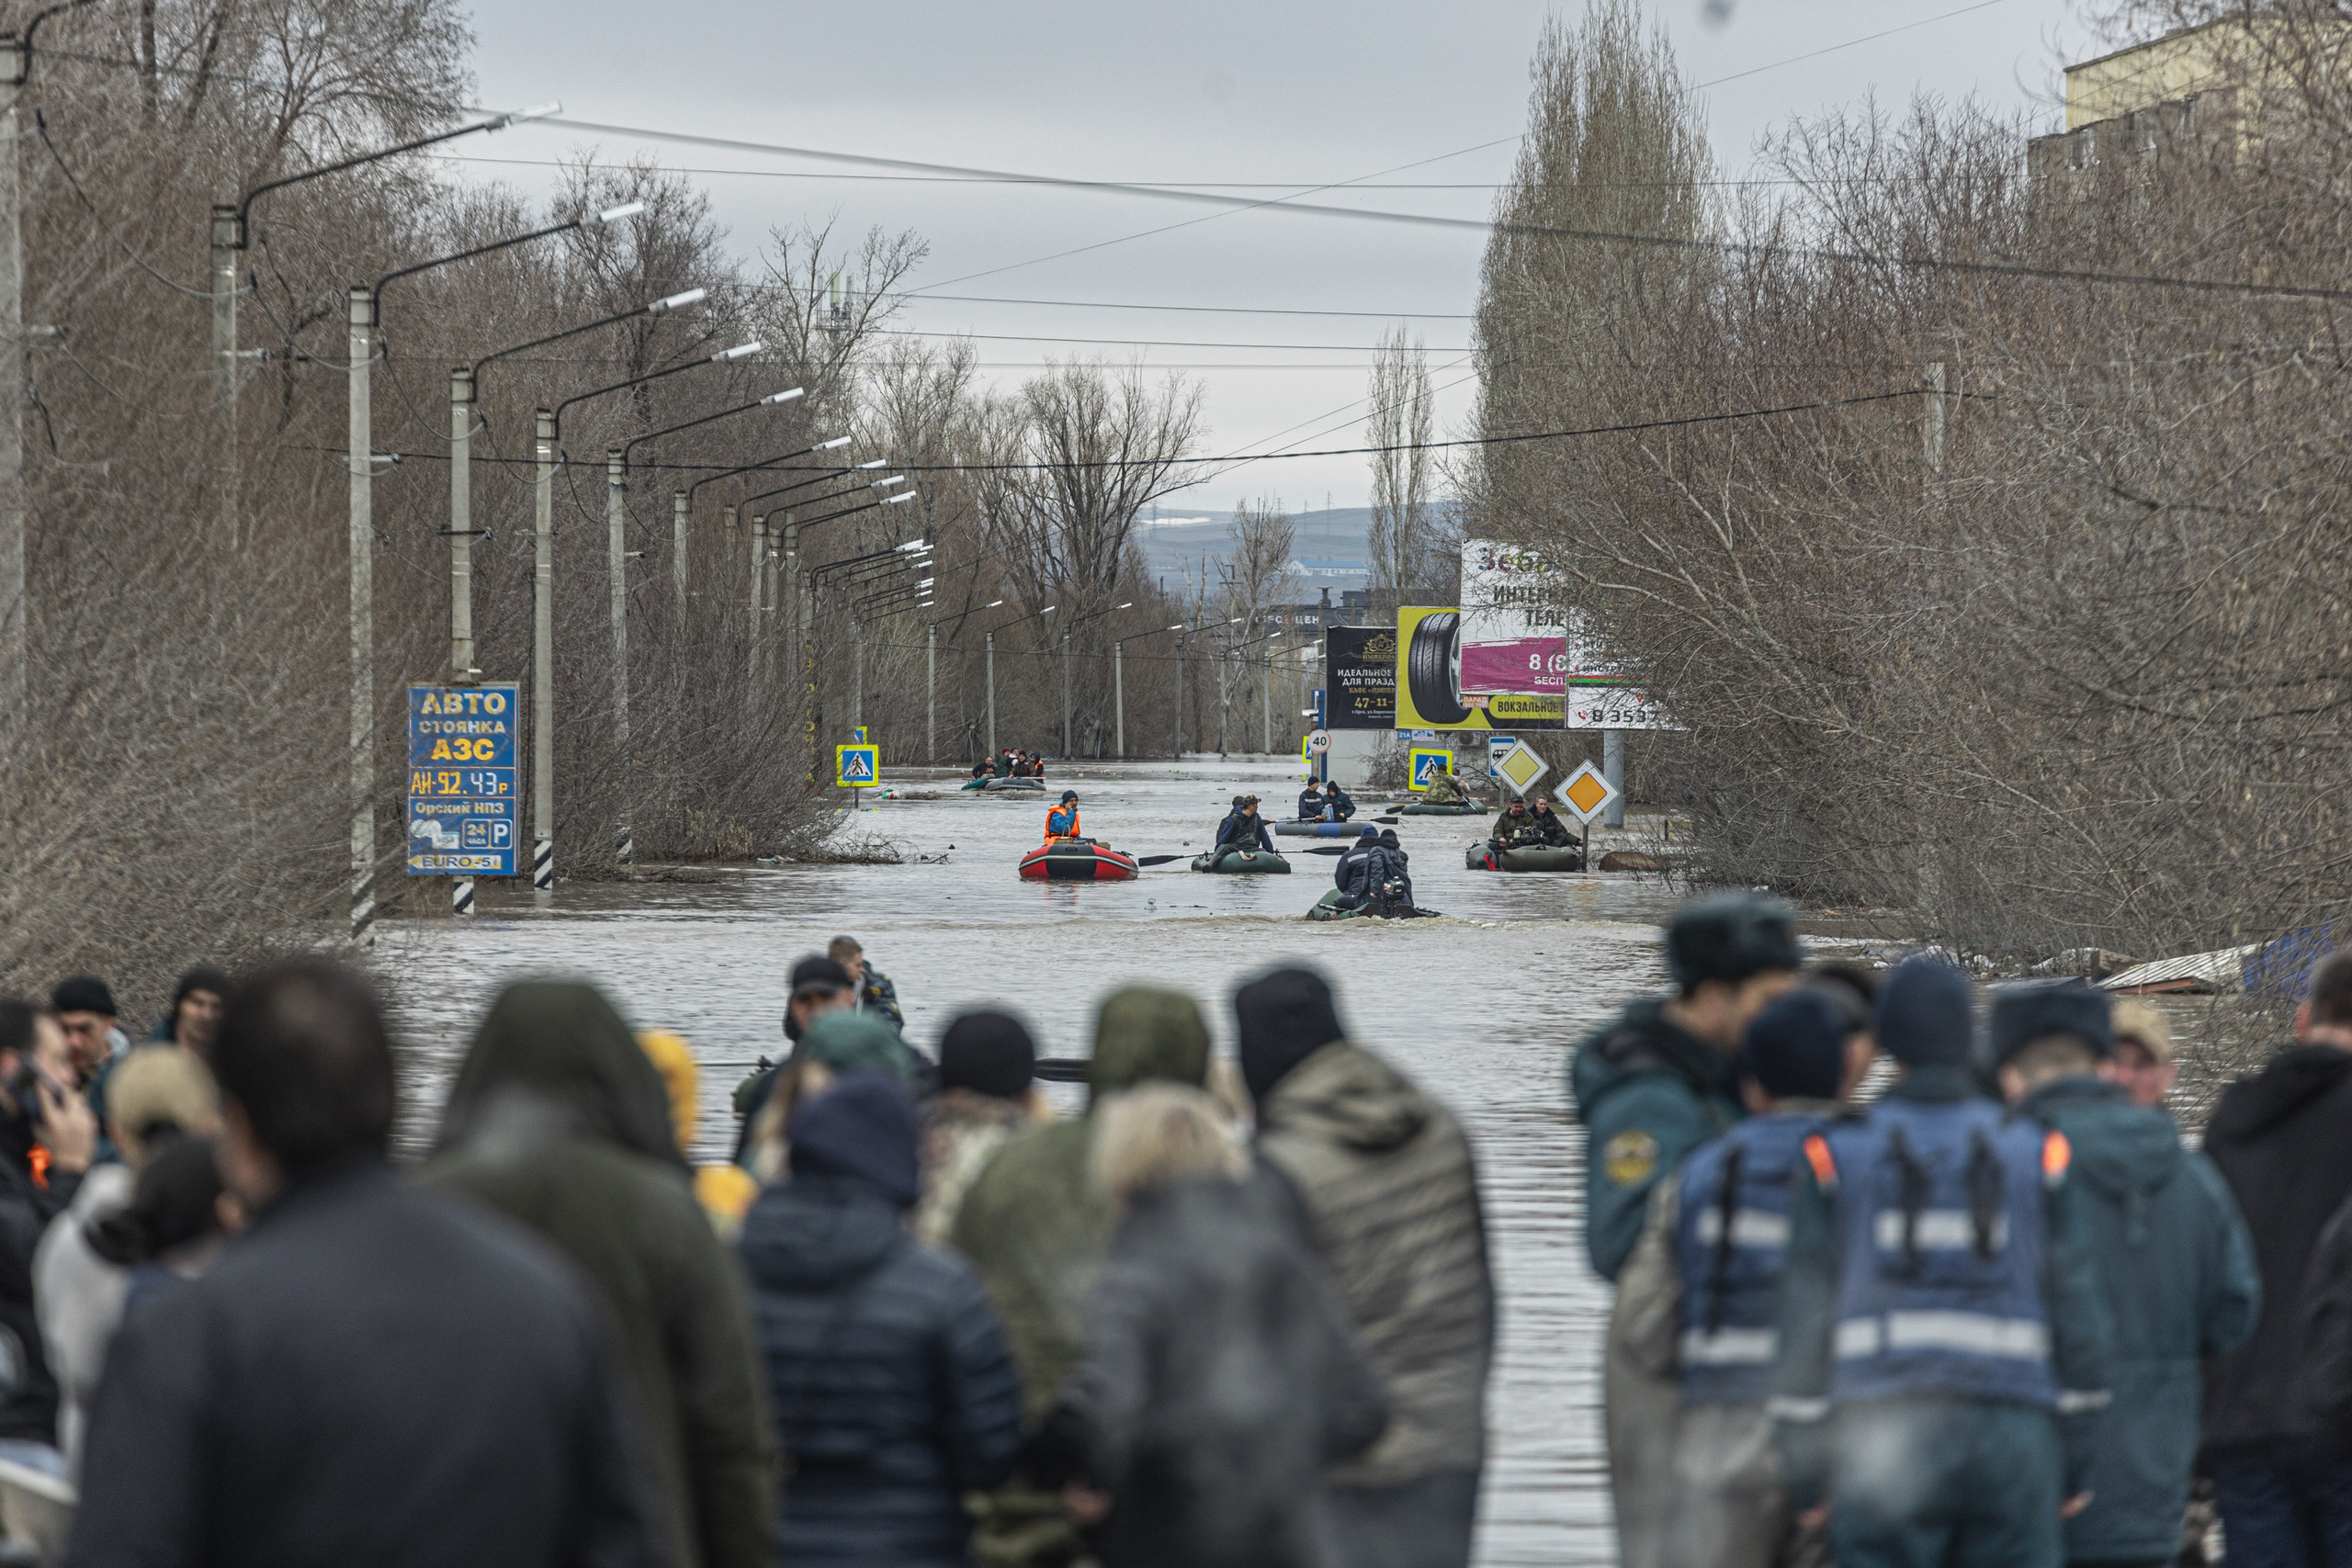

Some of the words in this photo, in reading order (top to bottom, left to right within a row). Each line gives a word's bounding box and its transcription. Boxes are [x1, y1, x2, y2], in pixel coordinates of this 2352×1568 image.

[1529, 653, 1542, 671] 8
[1337, 669, 1392, 678] ИДЕАЛЬНОЕ
[1341, 678, 1362, 686] ДЛЯ
[1364, 678, 1396, 686] ПРАЗД
[421, 692, 506, 715] АВТО
[1354, 697, 1394, 708] 47-11-
[1498, 701, 1558, 713] ВОКЗАЛЬНОЕ
[1592, 709, 1604, 723] 8
[419, 720, 506, 734] СТОЯНКА
[1312, 736, 1327, 747] 40
[431, 738, 494, 761] АЗС
[415, 801, 470, 816] Орский
[474, 802, 504, 814] НПЗ
[467, 823, 487, 836] 24
[422, 856, 492, 868] EURO-5
